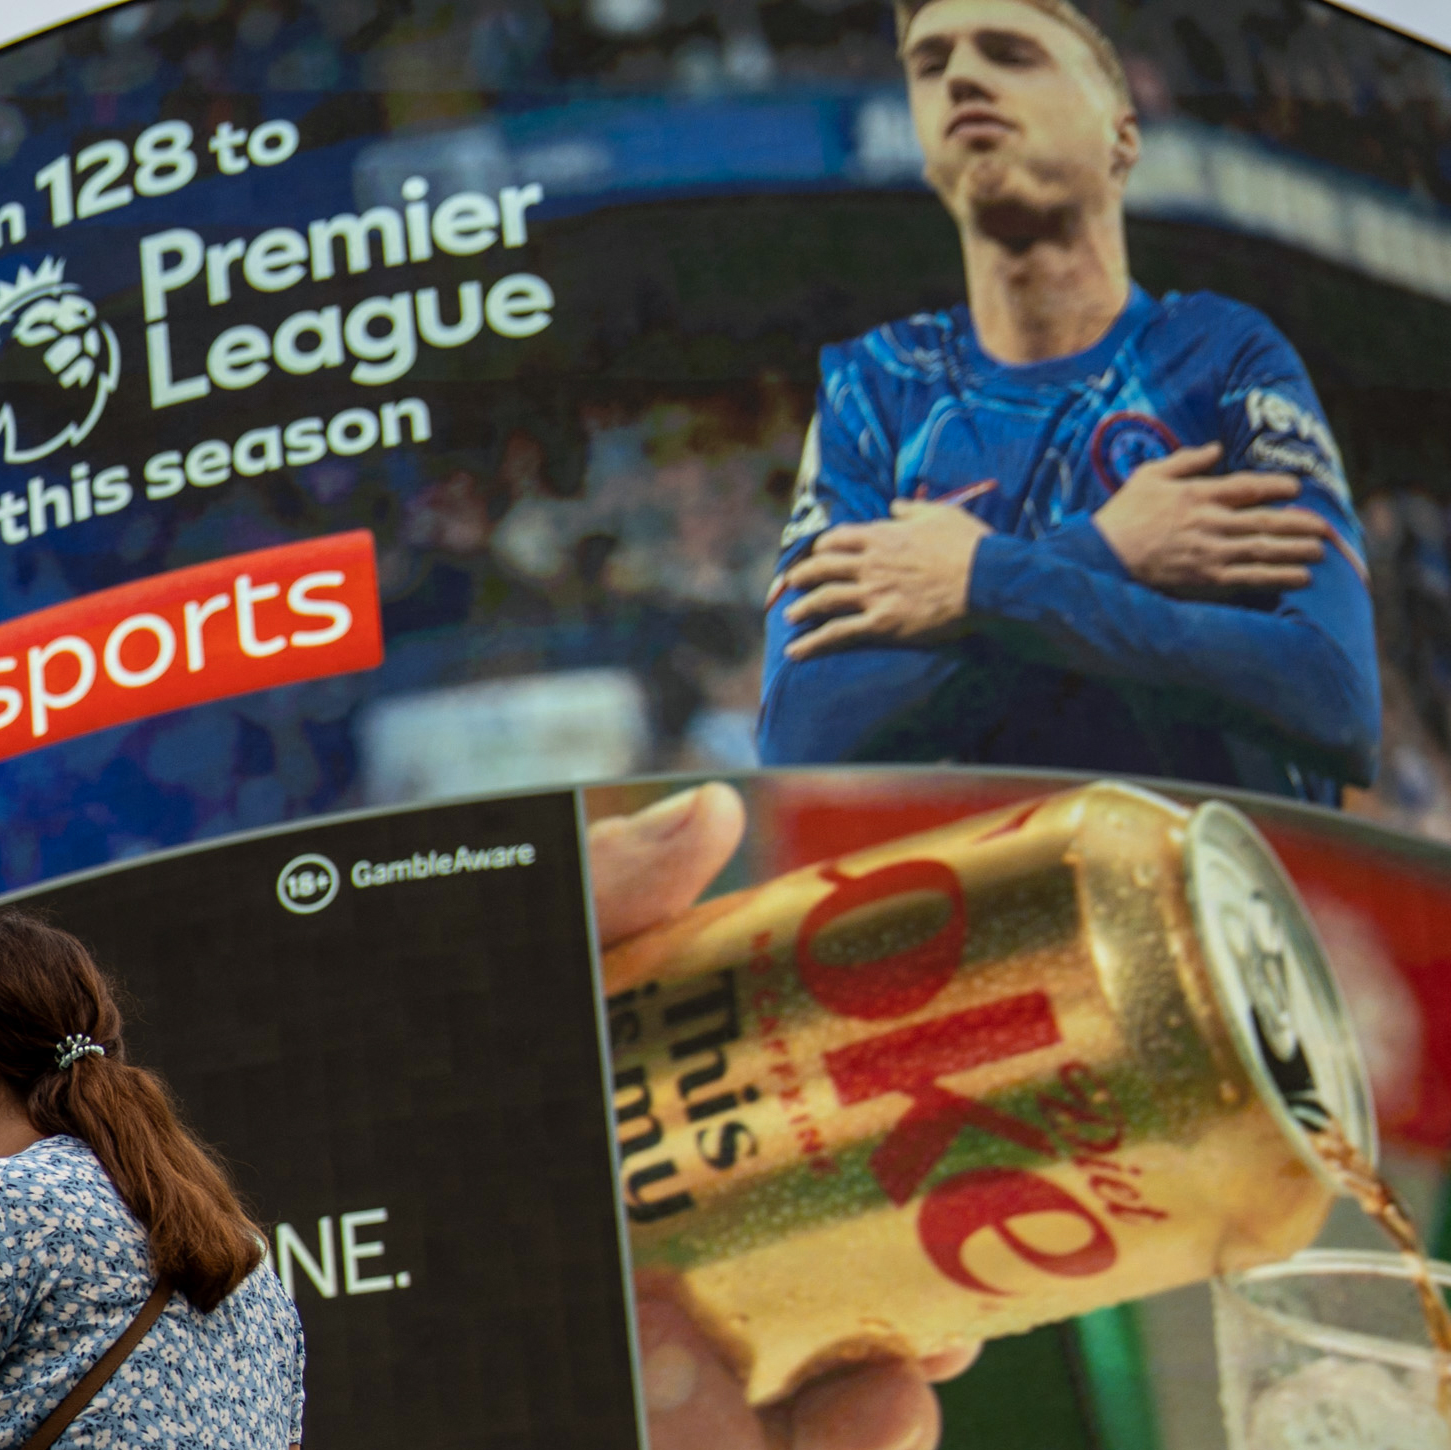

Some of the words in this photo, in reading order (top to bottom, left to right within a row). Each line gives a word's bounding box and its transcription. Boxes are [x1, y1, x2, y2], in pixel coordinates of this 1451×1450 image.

[34, 119, 198, 227] 128
[208, 117, 300, 176] to
[141, 175, 544, 322] Premier
[145, 271, 555, 410] League
[144, 397, 432, 502] season
[285, 869, 332, 900] 18+
[350, 842, 537, 889] GambleAware
[661, 967, 761, 1172] This
[797, 804, 1118, 1300] oke
[612, 1065, 697, 1224] my
[1036, 1058, 1169, 1225] Diet
[266, 1206, 412, 1300] NE.
